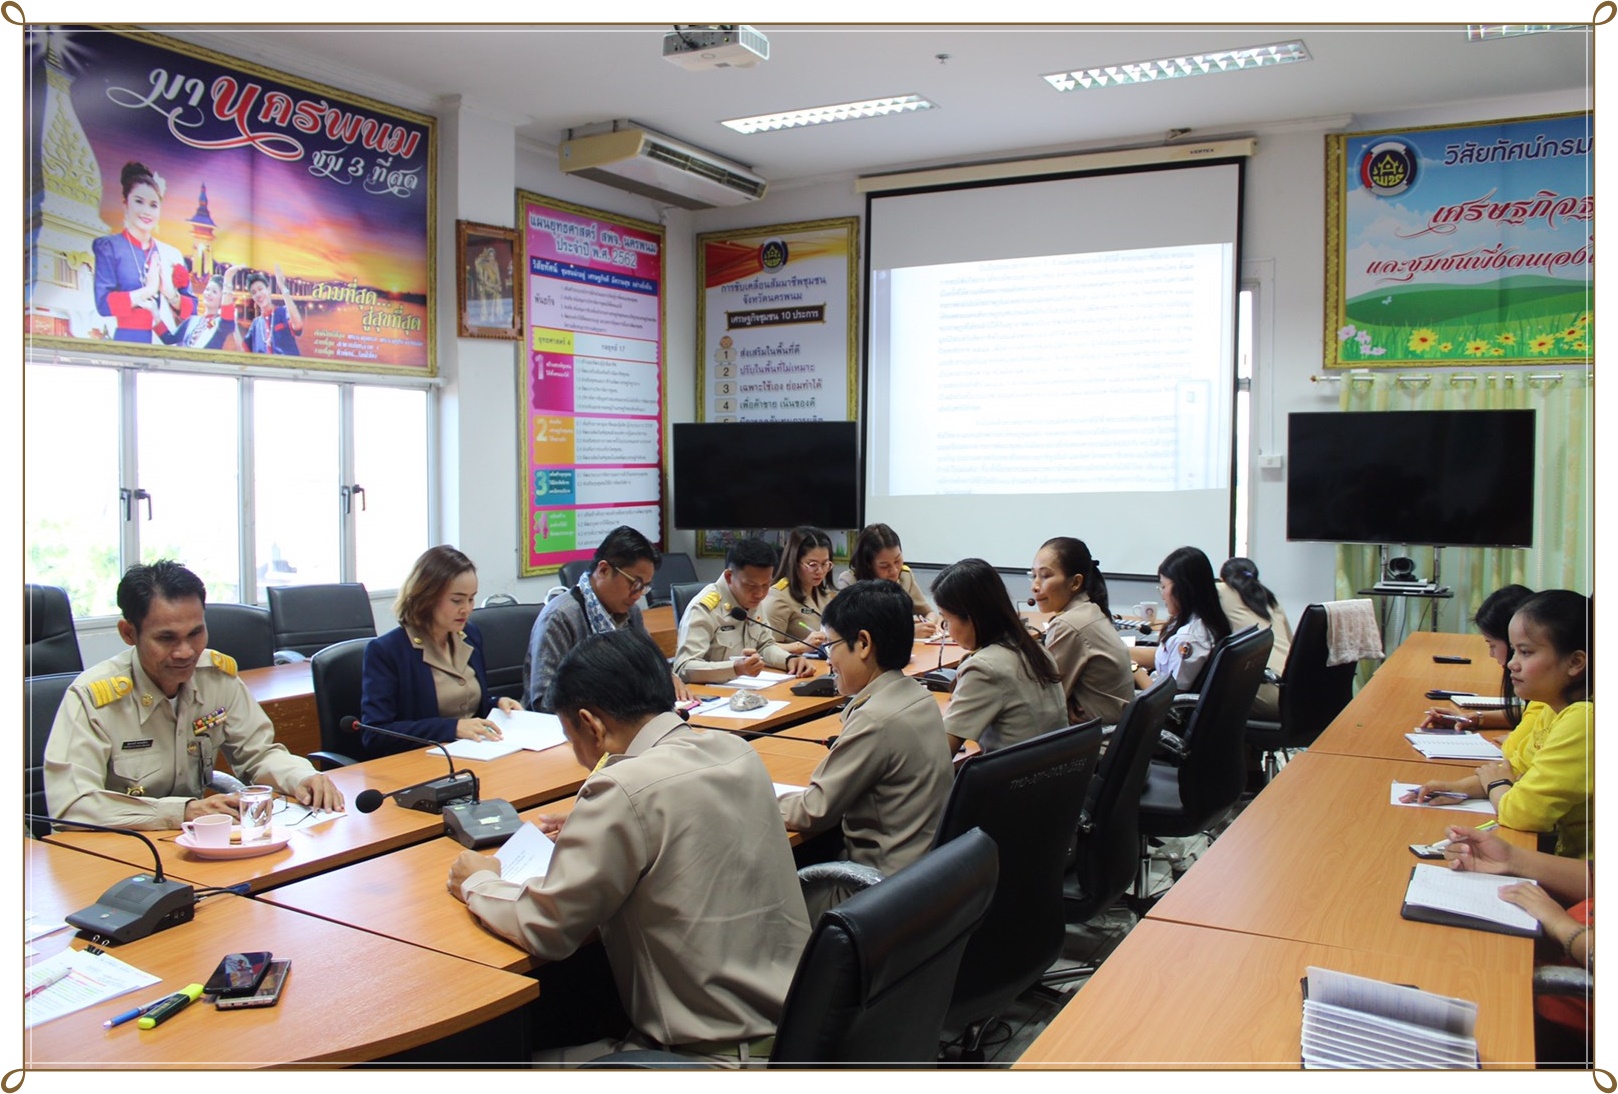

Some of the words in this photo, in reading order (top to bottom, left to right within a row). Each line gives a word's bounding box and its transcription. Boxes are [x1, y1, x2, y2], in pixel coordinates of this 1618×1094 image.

[106, 68, 205, 127] มา
[168, 75, 421, 161] นครพนม
[308, 144, 351, 184] ชม
[348, 156, 365, 176] 3
[362, 156, 423, 198] ที่สุด
[529, 213, 597, 238] แผนยุทธศาสตร์
[623, 237, 657, 254] นครพนม
[556, 237, 592, 257] ประจำปี
[592, 247, 611, 261] พ.ศ.
[611, 250, 638, 268] 2562
[743, 291, 803, 304] จังหวัดนครพนม
[730, 313, 779, 325] เศรษฐกิจชุมชน
[781, 312, 791, 320] 10
[792, 309, 819, 319] ประการ
[534, 353, 544, 380] 1
[723, 350, 729, 359] 1
[723, 367, 730, 377] 2
[723, 384, 730, 393] 3
[723, 401, 730, 411] 4
[536, 418, 548, 442] 2
[535, 470, 548, 496] 3
